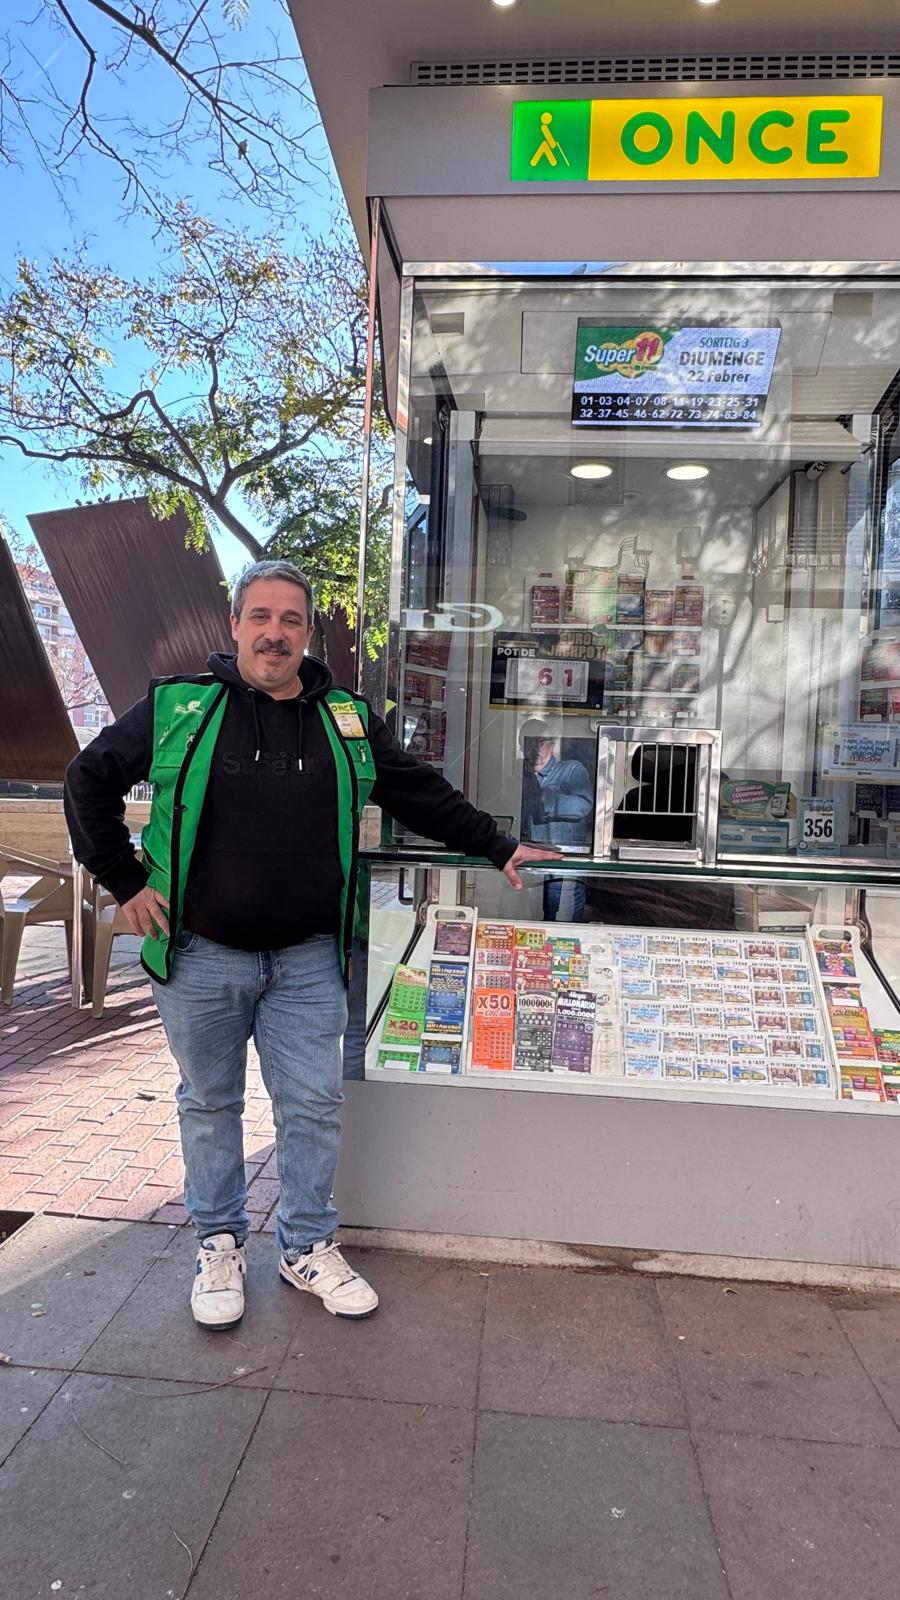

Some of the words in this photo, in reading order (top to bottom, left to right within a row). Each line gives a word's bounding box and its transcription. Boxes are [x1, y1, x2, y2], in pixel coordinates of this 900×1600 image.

[620, 109, 851, 165] ONCE
[699, 337, 740, 349] SORTEIG
[742, 338, 750, 348] 3
[584, 344, 637, 367] Super
[636, 337, 661, 360] 11
[679, 351, 765, 367] DIUMENGE
[687, 370, 704, 382] 22
[707, 370, 752, 383] Febrer
[497, 647, 519, 657] POT
[521, 648, 536, 657] DE
[331, 704, 356, 712] ONCE
[804, 818, 833, 837] 356
[478, 994, 511, 1010] x50
